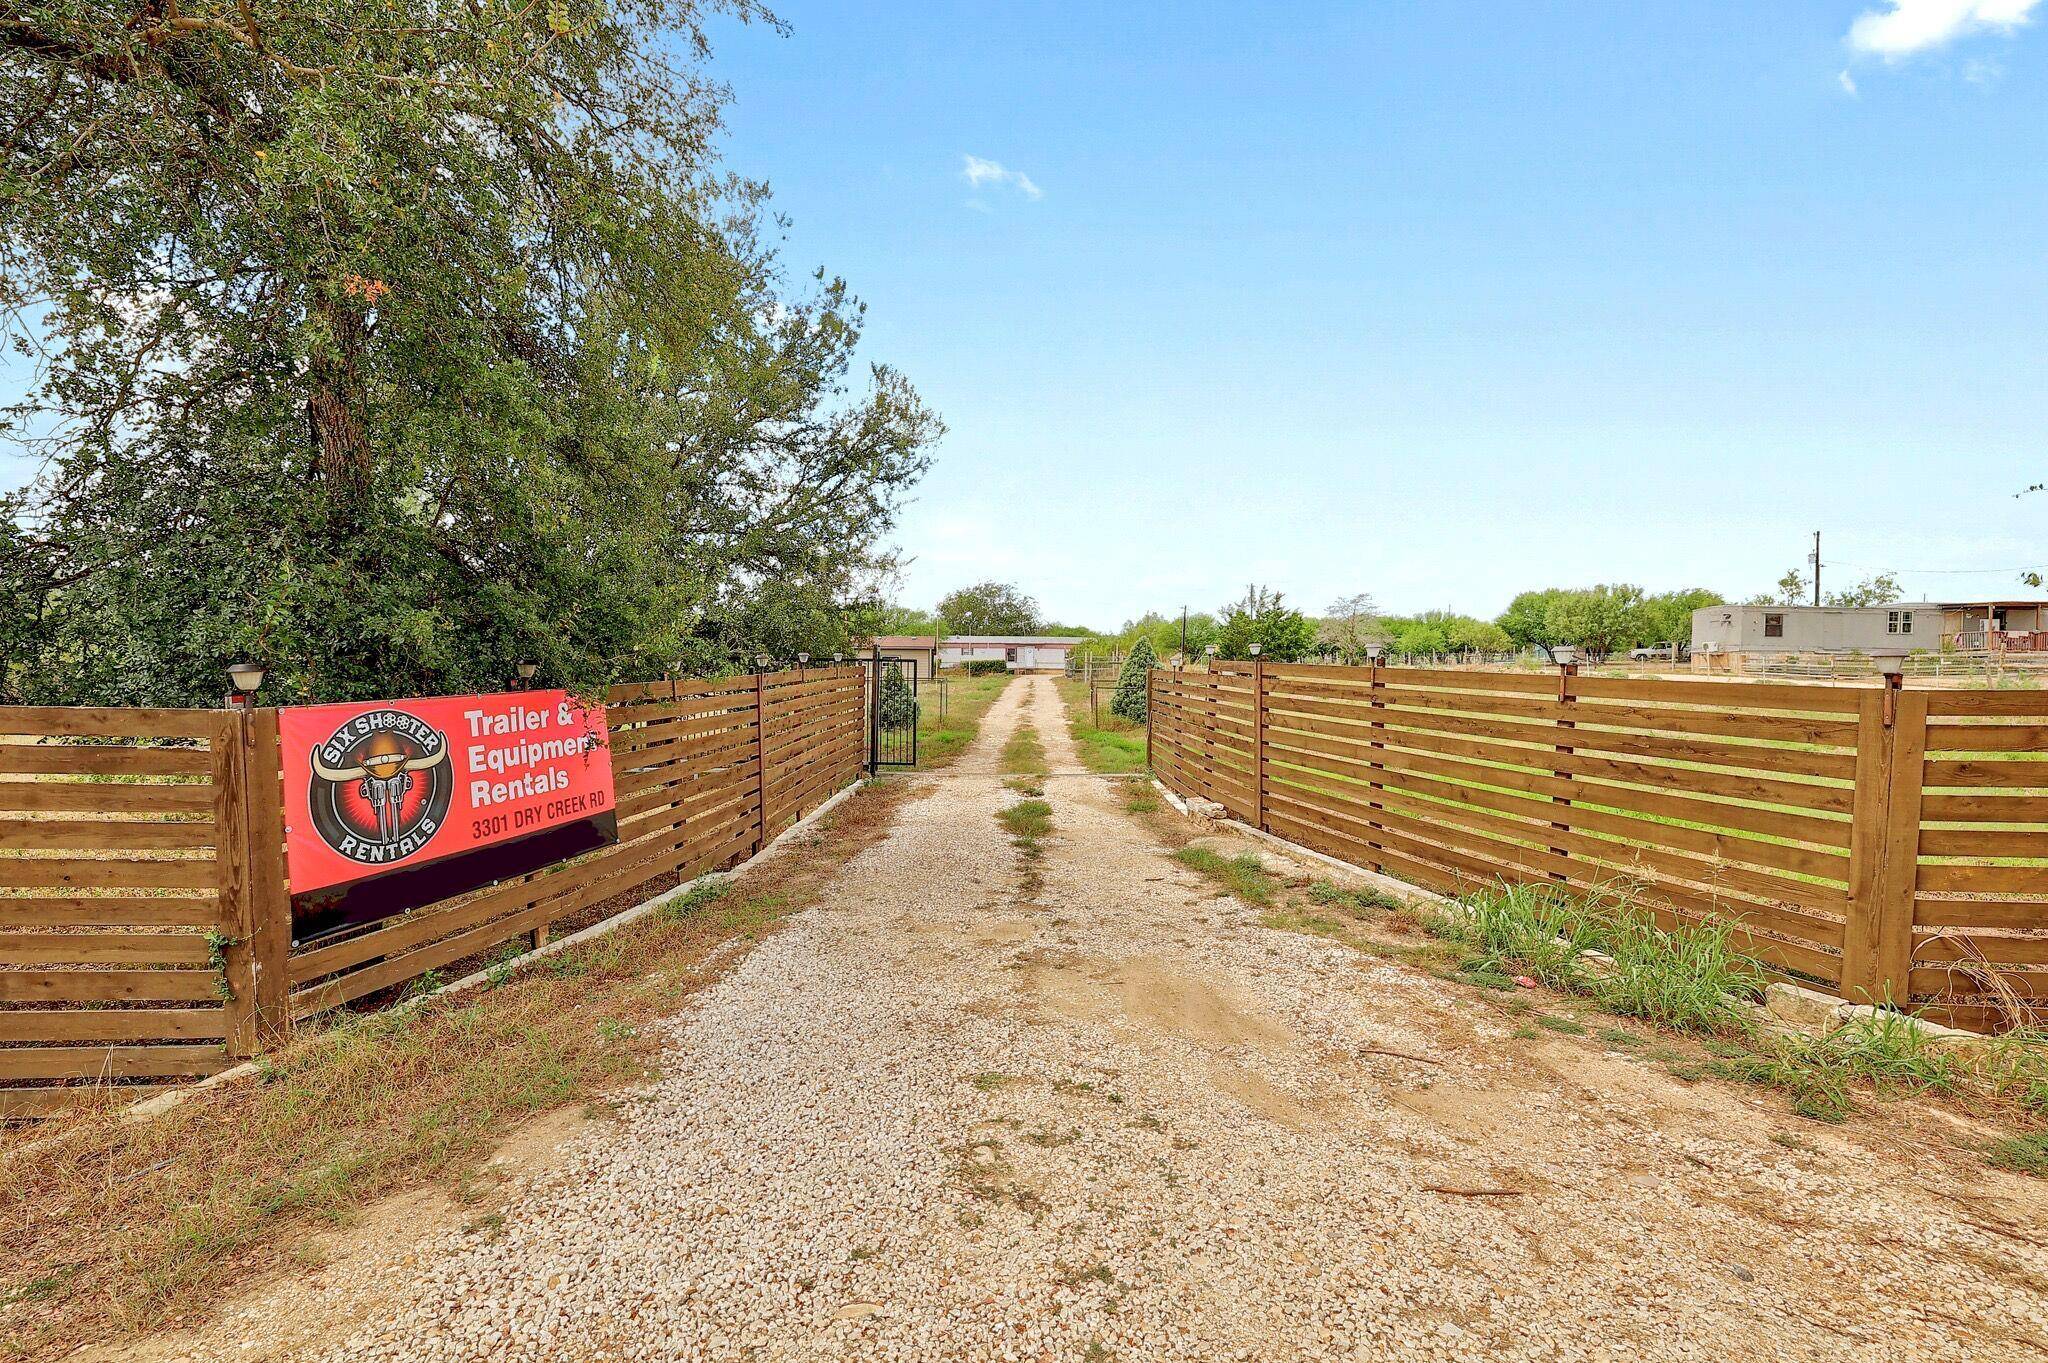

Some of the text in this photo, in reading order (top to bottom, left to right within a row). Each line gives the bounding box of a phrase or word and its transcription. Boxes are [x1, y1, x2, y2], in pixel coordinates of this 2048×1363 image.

[323, 712, 439, 764] SIX SHOOTER
[464, 702, 574, 737] Trailer &
[470, 767, 569, 808] Rentals
[472, 790, 605, 839] 3301 DRY CREEK RD
[339, 818, 436, 862] RENTALS
